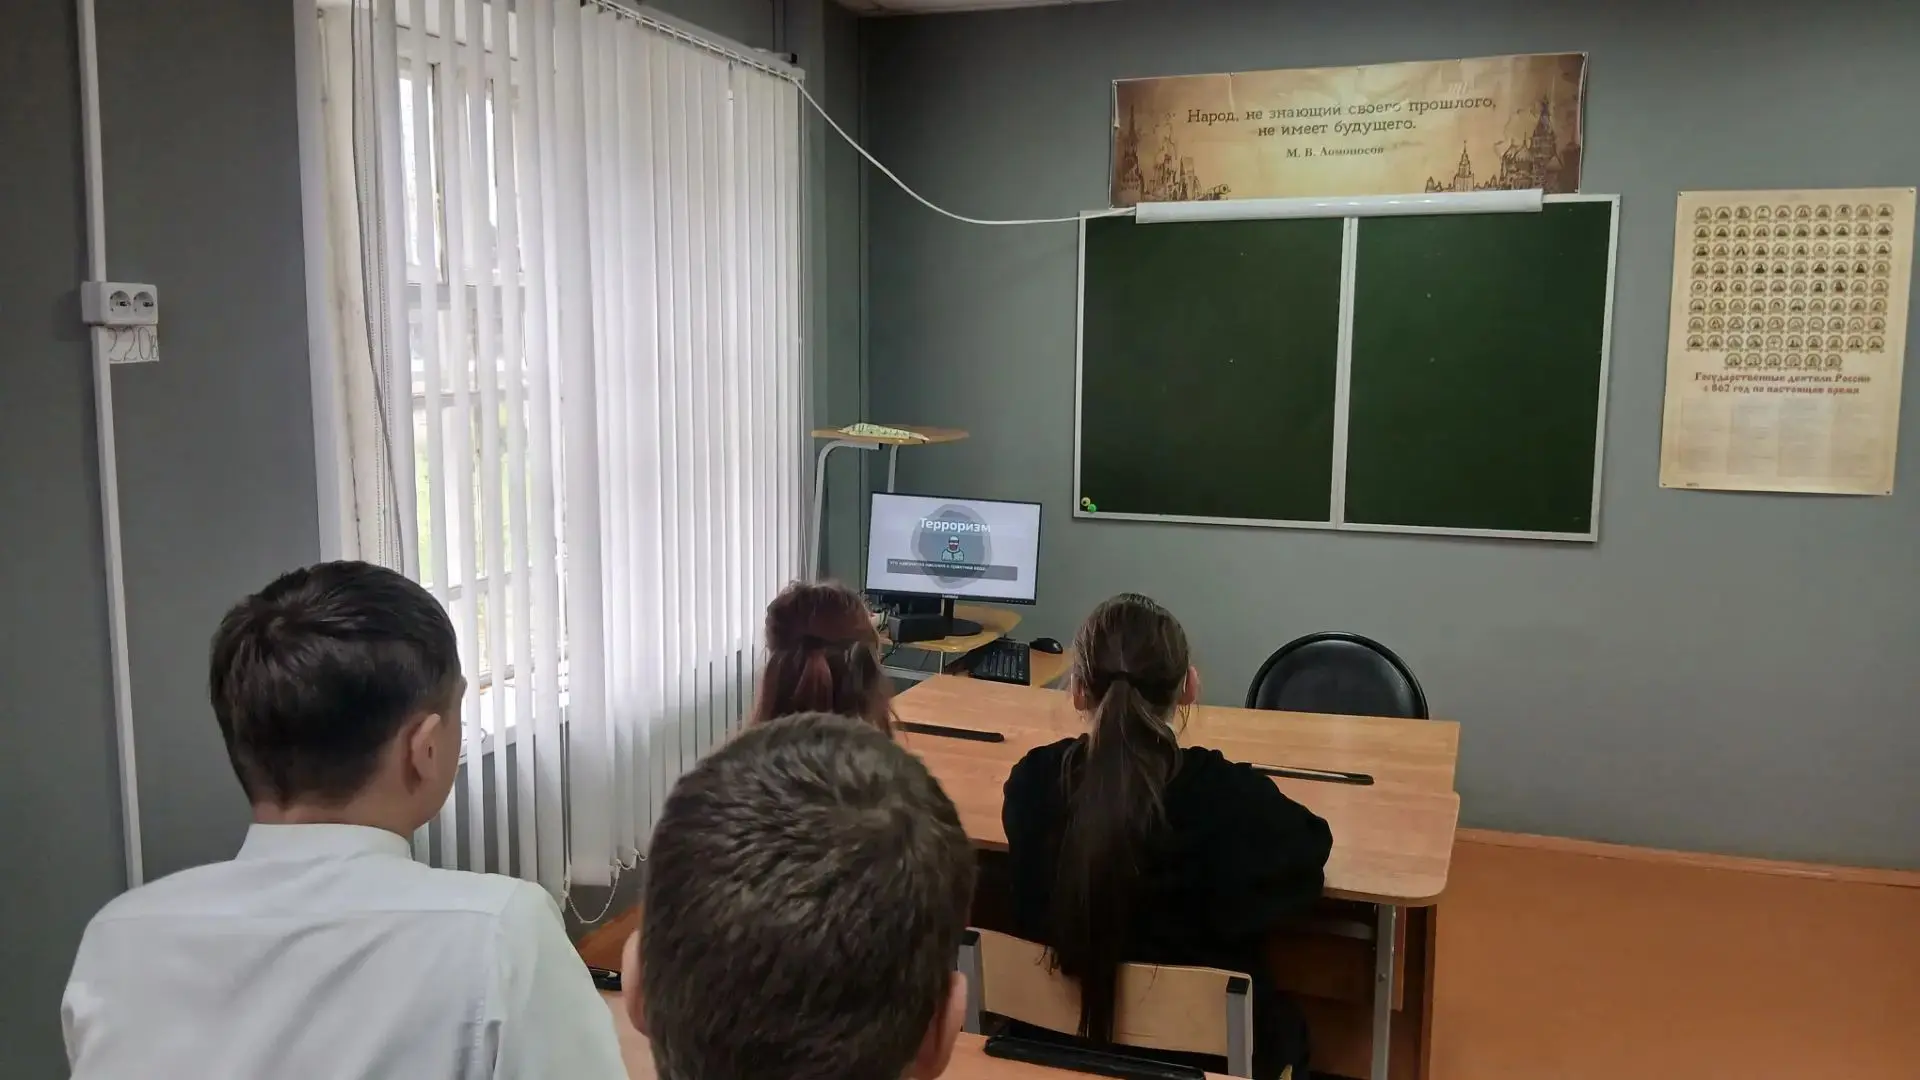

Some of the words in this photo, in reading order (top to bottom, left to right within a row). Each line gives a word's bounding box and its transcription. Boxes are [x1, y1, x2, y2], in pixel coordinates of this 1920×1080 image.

[1187, 109, 1239, 126] Народ,
[1246, 110, 1263, 120] не
[1269, 106, 1342, 119] знающий
[1348, 102, 1401, 115] своего
[1409, 97, 1497, 115] прошлого,
[1258, 126, 1275, 137] не
[1281, 124, 1329, 136] имеет
[1334, 119, 1417, 136] будущего.
[1286, 148, 1300, 158] М.
[1305, 147, 1317, 157] В.
[1319, 146, 1385, 158] Ломоносов
[1833, 373, 1871, 383] России
[919, 517, 991, 533] Терроризм
